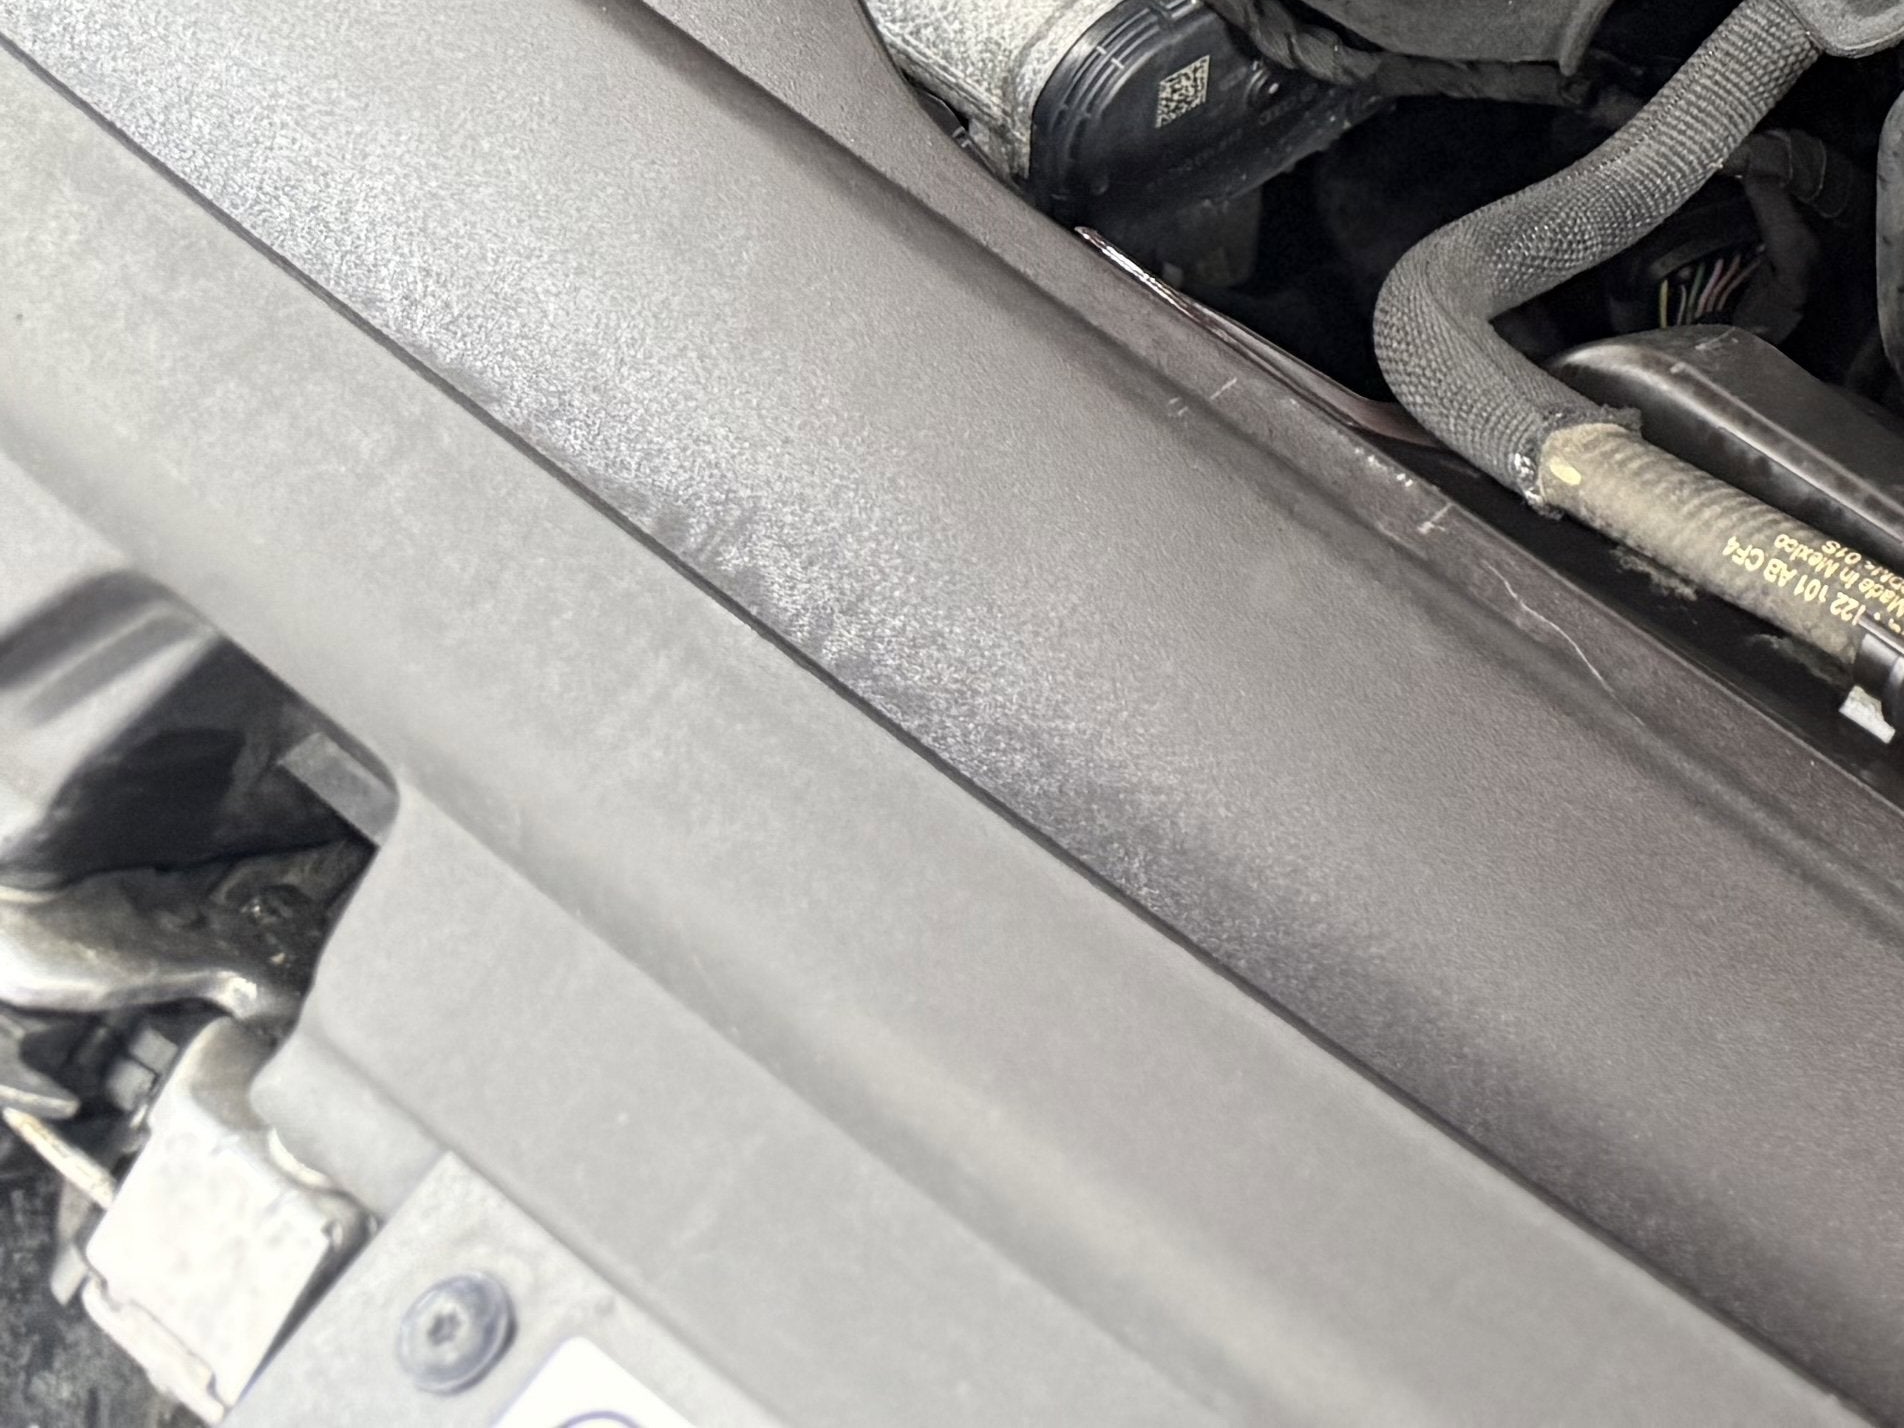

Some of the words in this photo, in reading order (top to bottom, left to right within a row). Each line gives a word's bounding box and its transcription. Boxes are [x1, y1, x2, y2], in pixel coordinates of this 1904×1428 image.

[1720, 531, 1769, 574] CF4
[1761, 555, 1798, 589] AB
[1770, 527, 1840, 582] Mexico
